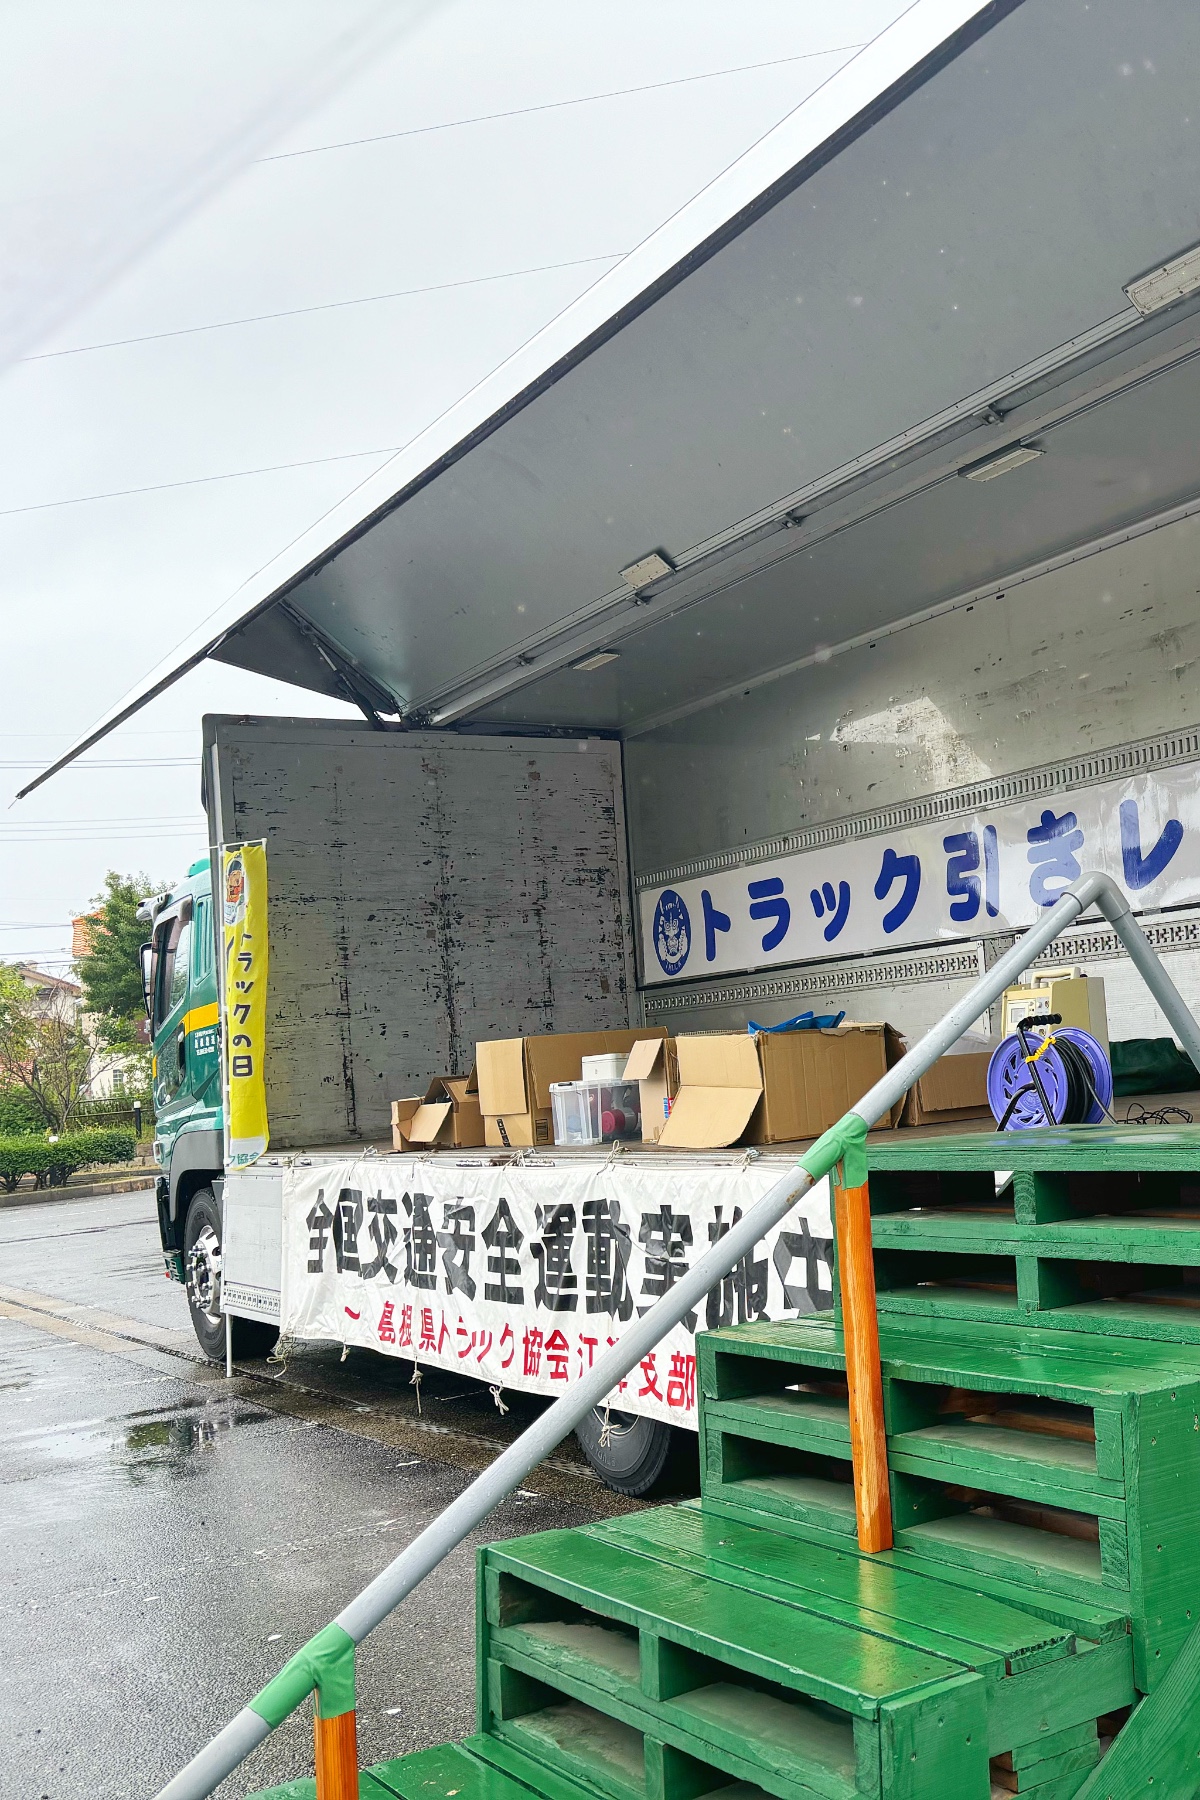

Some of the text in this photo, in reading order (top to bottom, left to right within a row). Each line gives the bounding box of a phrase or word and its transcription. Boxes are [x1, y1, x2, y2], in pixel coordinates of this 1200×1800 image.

[377, 1300, 697, 1412] 島根県トラック協会江支部
